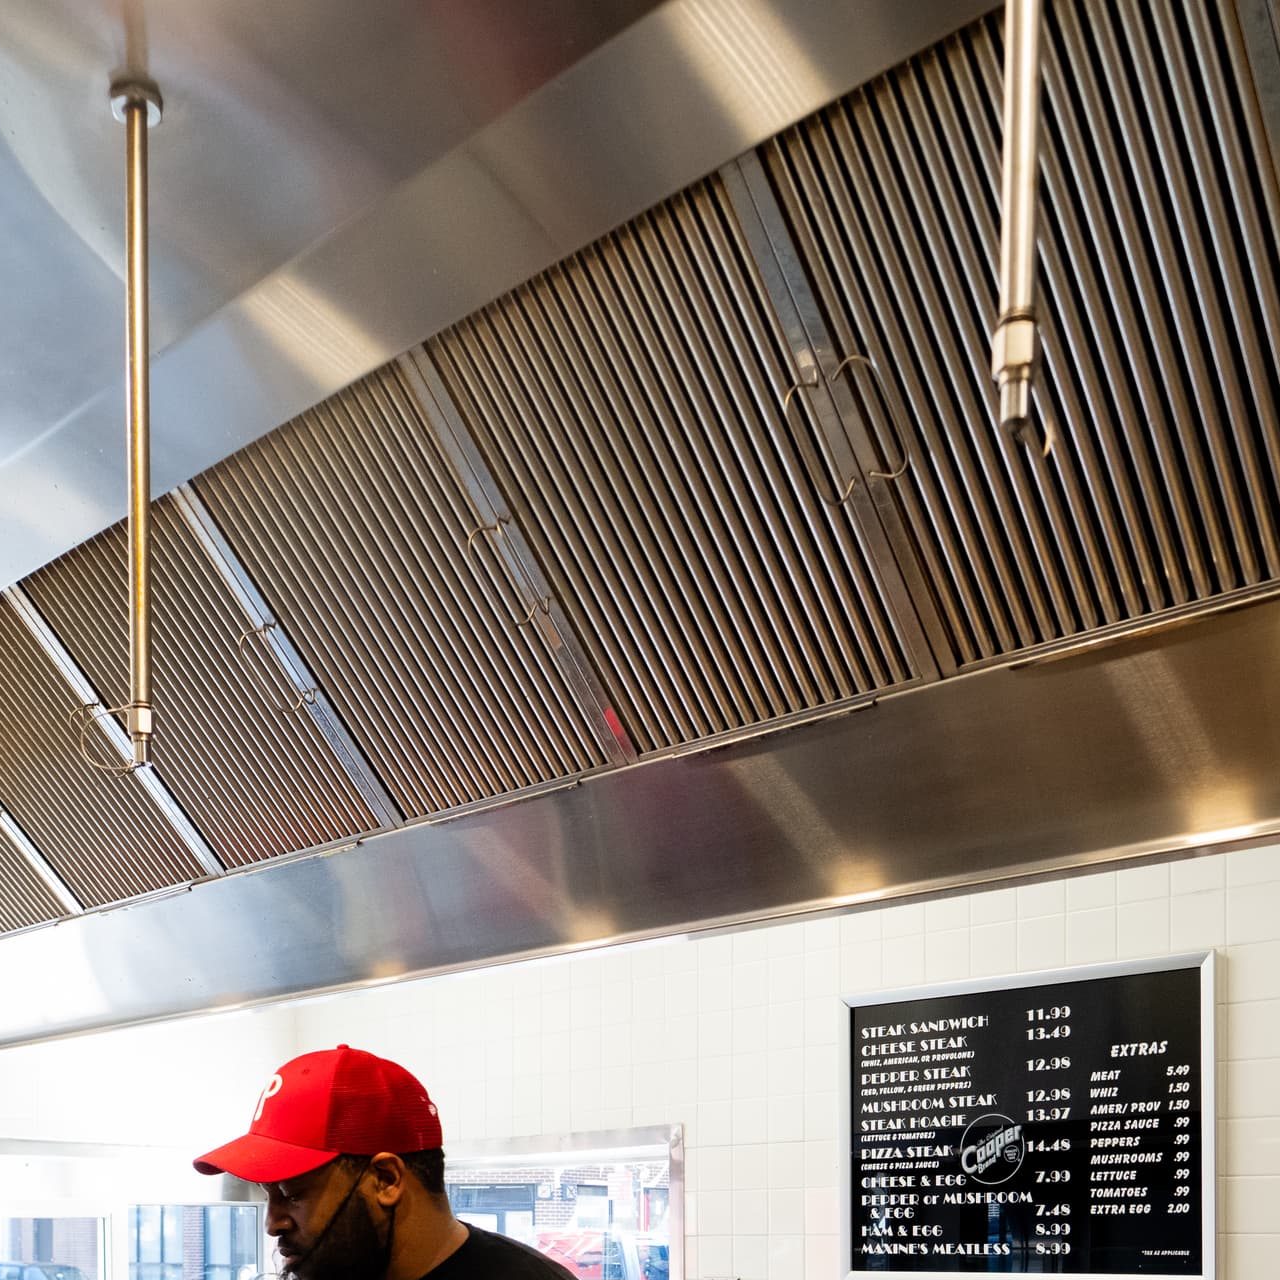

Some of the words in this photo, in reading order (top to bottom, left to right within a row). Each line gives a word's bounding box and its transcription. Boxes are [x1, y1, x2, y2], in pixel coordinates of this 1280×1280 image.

[861, 1024, 907, 1040] STEAK
[910, 1015, 989, 1034] SANDWICH
[1026, 1006, 1071, 1021] 11.99
[861, 1041, 916, 1057] CHEESE
[920, 1036, 968, 1052] STEAK
[1026, 1025, 1071, 1041] 13.49
[1110, 1040, 1168, 1058] EXTRAS
[861, 1070, 920, 1085] PEPPER
[923, 1065, 972, 1081] STEAK
[1026, 1056, 1071, 1072] 12.98
[1090, 1069, 1122, 1082] MEAT
[1166, 1064, 1190, 1077] 5.49
[913, 1083, 935, 1092] GREEN
[936, 1081, 972, 1091] PEPPERS)
[1089, 1087, 1119, 1098] WHIZ
[1168, 1082, 1190, 1093] 1.50
[253, 1073, 283, 1121] P
[860, 1097, 945, 1114] MUSHROOM
[948, 1093, 999, 1108] STEAK
[1026, 1088, 1071, 1103] 12.98
[1090, 1103, 1129, 1115] AMER/
[1130, 1101, 1161, 1113] PROV
[1168, 1099, 1190, 1111] 1.50
[861, 1118, 907, 1132] STEAK
[910, 1115, 967, 1129] HOAGIE
[1026, 1107, 1071, 1122] 13.97
[1090, 1120, 1121, 1132] PIZZA
[1124, 1118, 1160, 1130] SAUCE
[1173, 1117, 1190, 1128] .99
[861, 1147, 903, 1160] PIZZA
[906, 1144, 954, 1158] STEAK
[1026, 1139, 1071, 1152] 14.48
[961, 1125, 1023, 1174] Cooper
[1090, 1136, 1141, 1149] PEPPERS
[1173, 1134, 1190, 1145] .99
[861, 1162, 889, 1171] (CHEESE
[894, 1161, 914, 1170] PIZZA
[914, 1160, 939, 1170] SAUCE)
[1090, 1152, 1163, 1165] MUSHROOMS
[1173, 1151, 1190, 1163] .99
[861, 1176, 917, 1189] CHEESE
[920, 1175, 931, 1187] &
[935, 1174, 967, 1187] EGG
[1035, 1170, 1071, 1183] 7.99
[1090, 1170, 1137, 1182] LETTUCE
[1173, 1168, 1190, 1180] .99
[861, 1194, 920, 1206] PEPPER
[923, 1194, 939, 1206] or
[943, 1191, 1033, 1205] MUSHROOM
[1090, 1186, 1149, 1199] TOMATOES
[1173, 1186, 1190, 1197] .99
[869, 1207, 881, 1219] &
[884, 1207, 915, 1219] EGG
[1035, 1203, 1071, 1217] 7.48
[1090, 1204, 1126, 1215] EXTRA
[1129, 1203, 1152, 1214] EGG
[1167, 1203, 1190, 1214] 2.00
[861, 1224, 893, 1237] HAM
[897, 1224, 908, 1237] &
[912, 1224, 943, 1237] EGG
[1035, 1223, 1071, 1236] 8.99
[861, 1242, 928, 1255] MAXINE'S
[932, 1242, 1011, 1255] MEATLESS
[1035, 1242, 1071, 1255] 8.99
